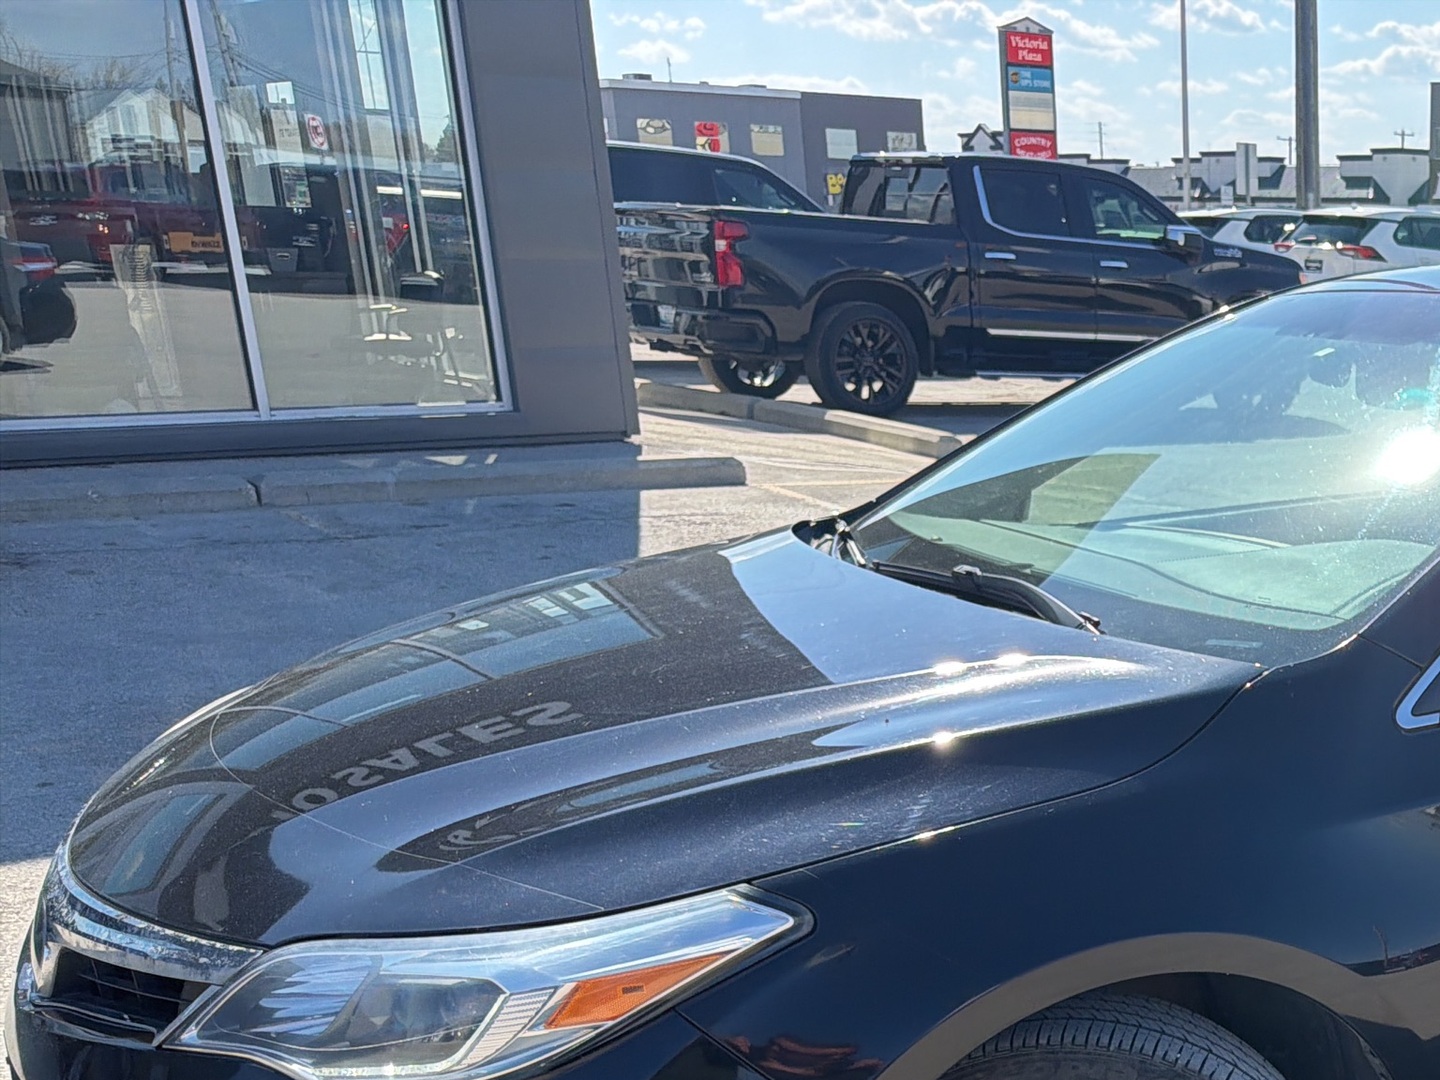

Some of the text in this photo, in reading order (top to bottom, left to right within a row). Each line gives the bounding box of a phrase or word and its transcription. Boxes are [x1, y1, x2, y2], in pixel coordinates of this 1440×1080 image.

[1010, 36, 1048, 49] Victoria
[1018, 50, 1042, 61] Plaza
[1014, 136, 1052, 148] COUNTRY
